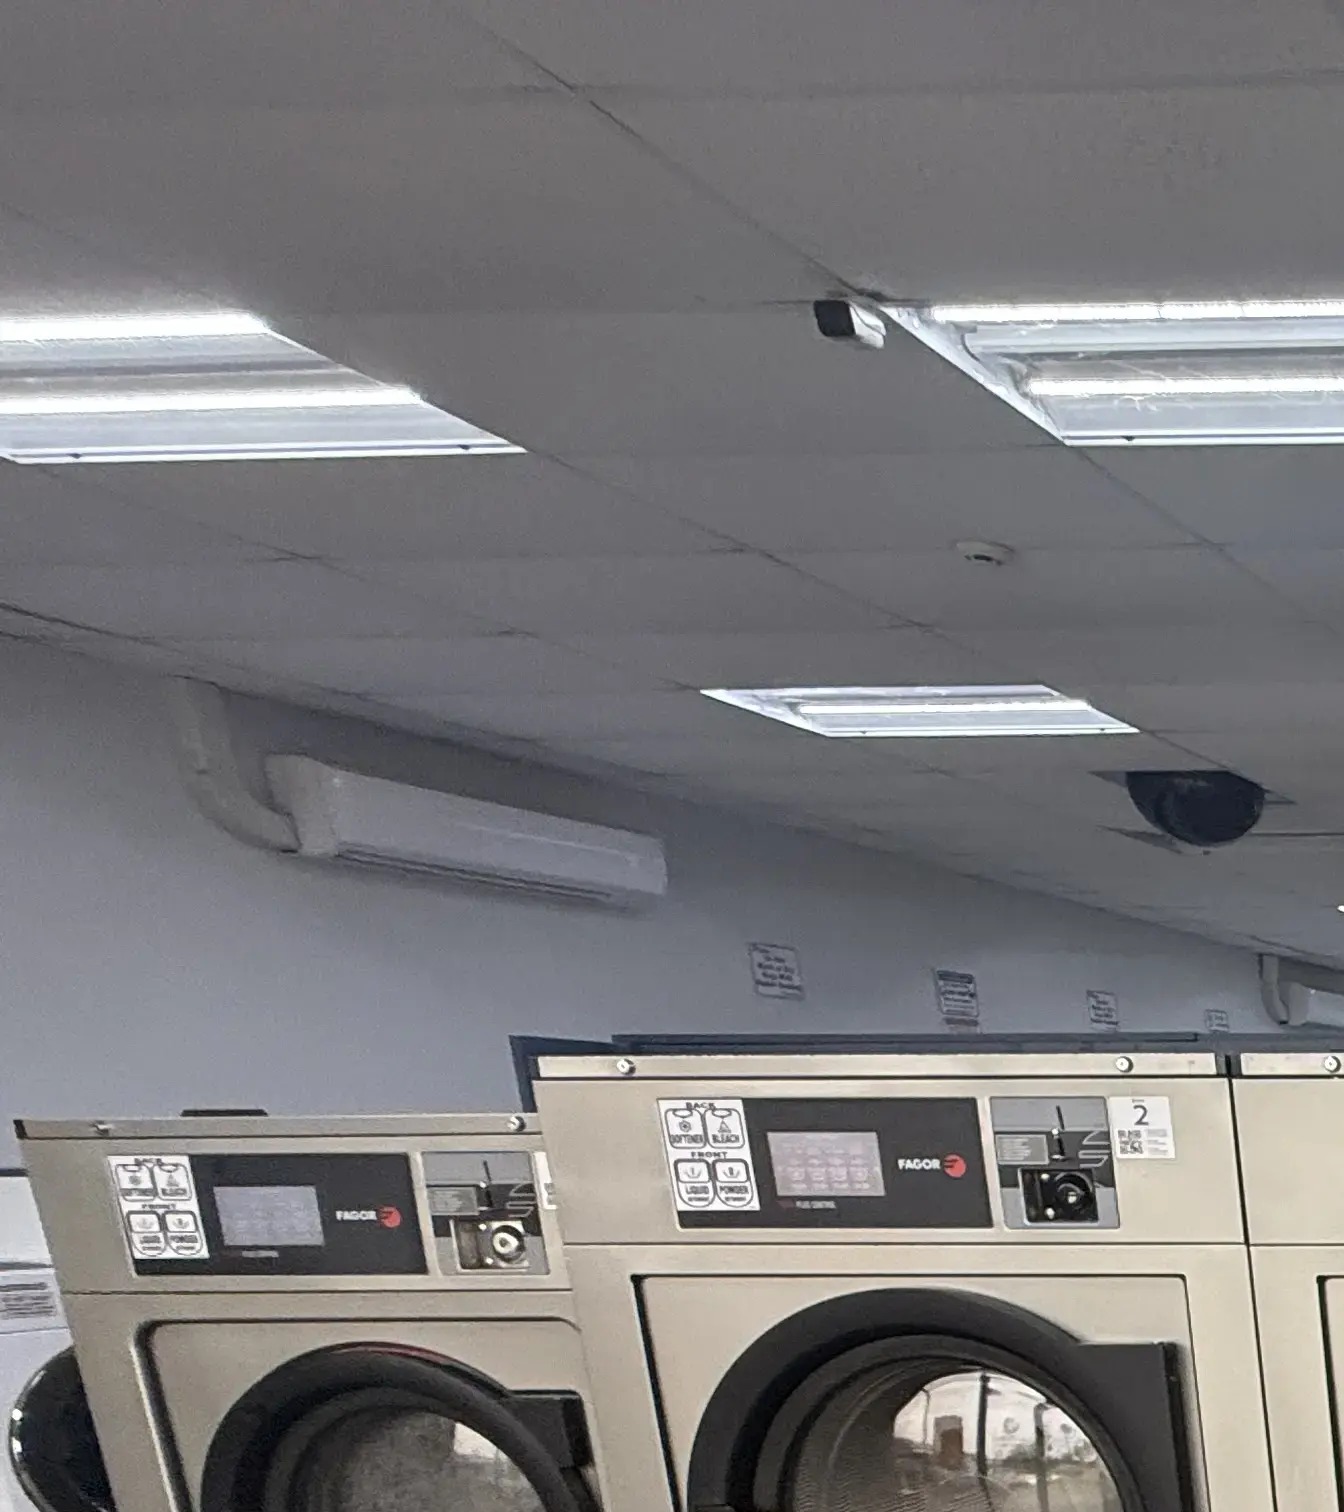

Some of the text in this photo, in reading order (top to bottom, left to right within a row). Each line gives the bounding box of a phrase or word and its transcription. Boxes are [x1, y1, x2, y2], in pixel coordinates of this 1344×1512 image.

[1132, 1105, 1149, 1126] 2
[690, 1151, 728, 1159] FRONT
[897, 1158, 941, 1171] FAGOR
[335, 1210, 377, 1221] FAGOR
